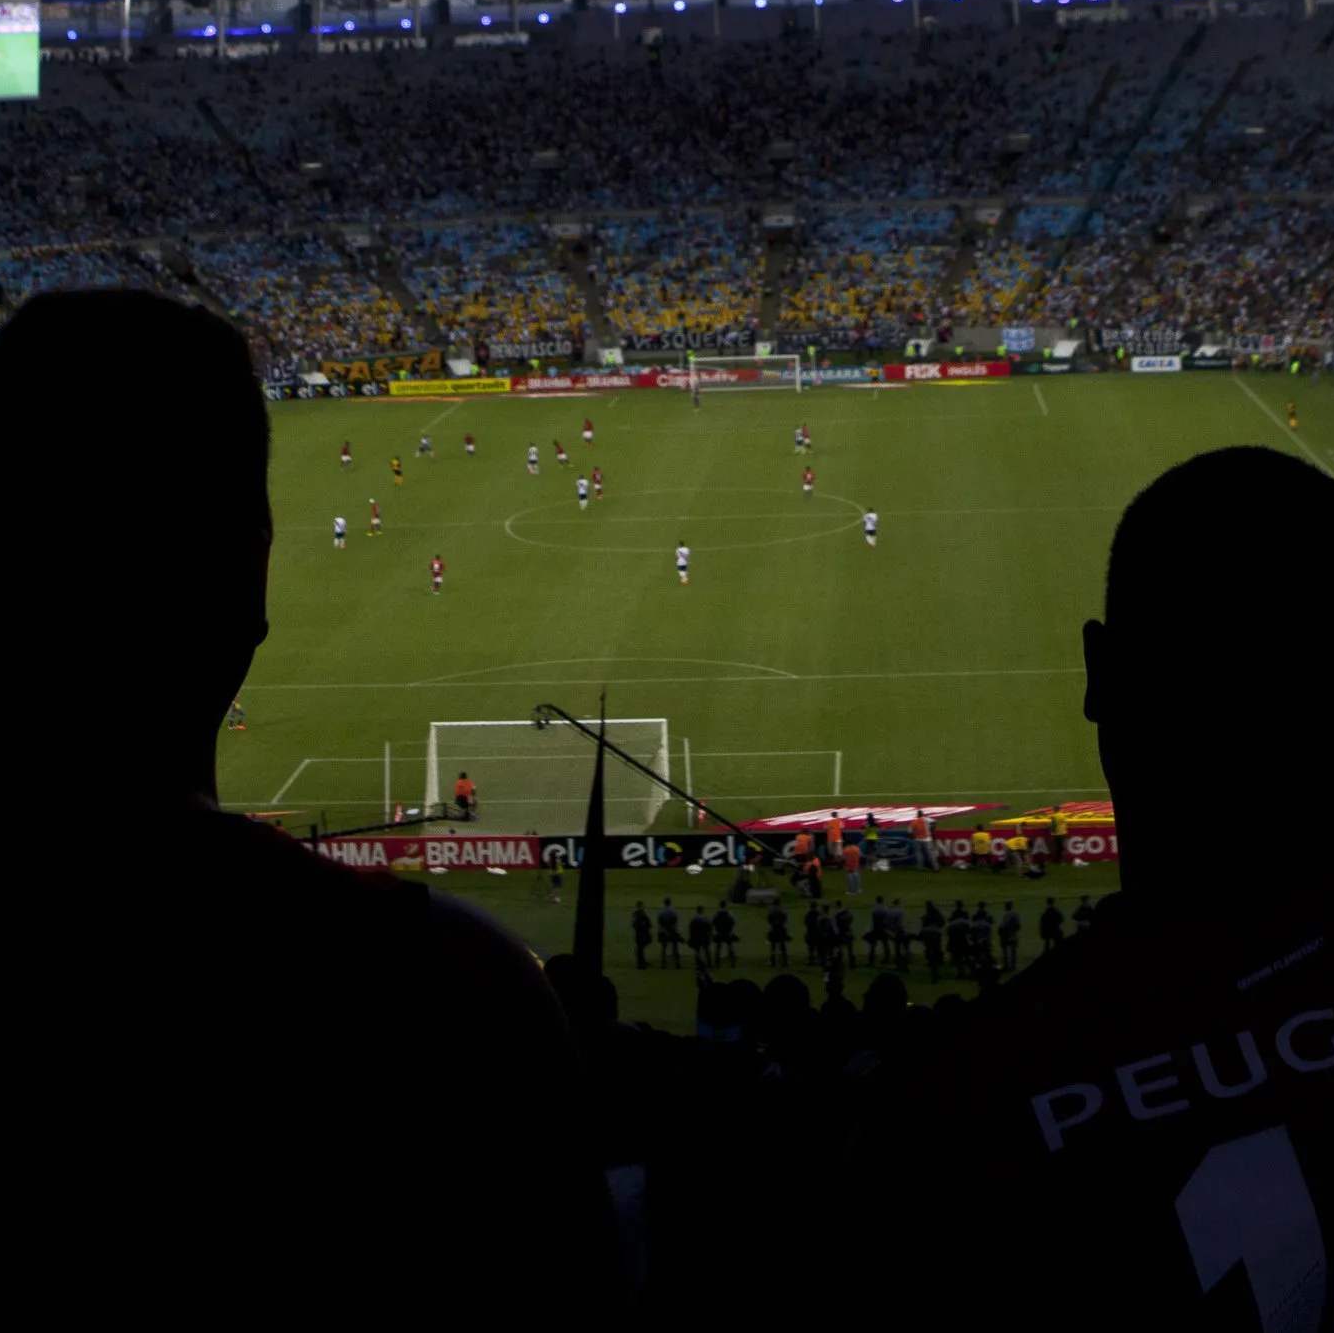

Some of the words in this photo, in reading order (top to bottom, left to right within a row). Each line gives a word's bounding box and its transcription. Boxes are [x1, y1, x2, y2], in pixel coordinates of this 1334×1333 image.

[425, 840, 535, 867] BRAHMA
[620, 835, 684, 868] elo
[700, 835, 764, 866] elo
